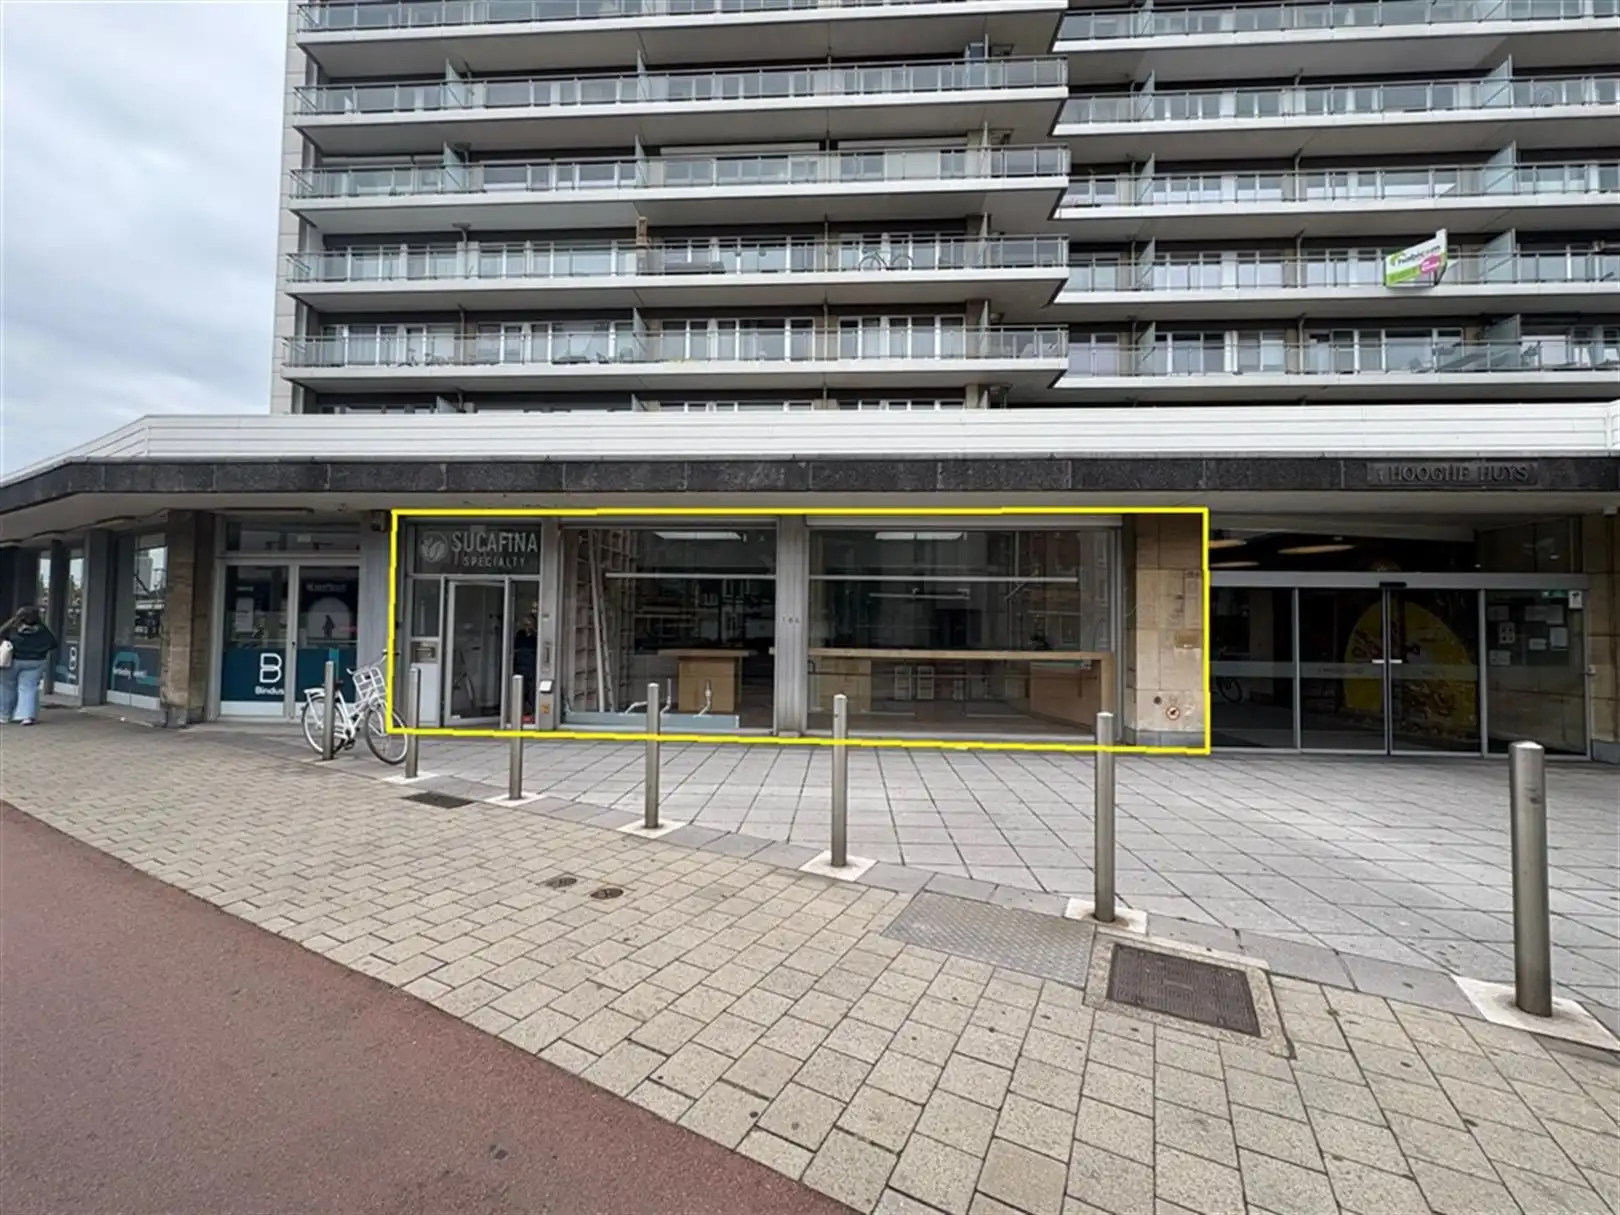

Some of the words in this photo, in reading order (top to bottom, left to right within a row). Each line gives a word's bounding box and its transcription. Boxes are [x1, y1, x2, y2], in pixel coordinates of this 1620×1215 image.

[1479, 465, 1529, 482] HUYS
[451, 531, 538, 553] SUCAFINA
[463, 556, 526, 569] SPECIALTY
[260, 652, 283, 684] B
